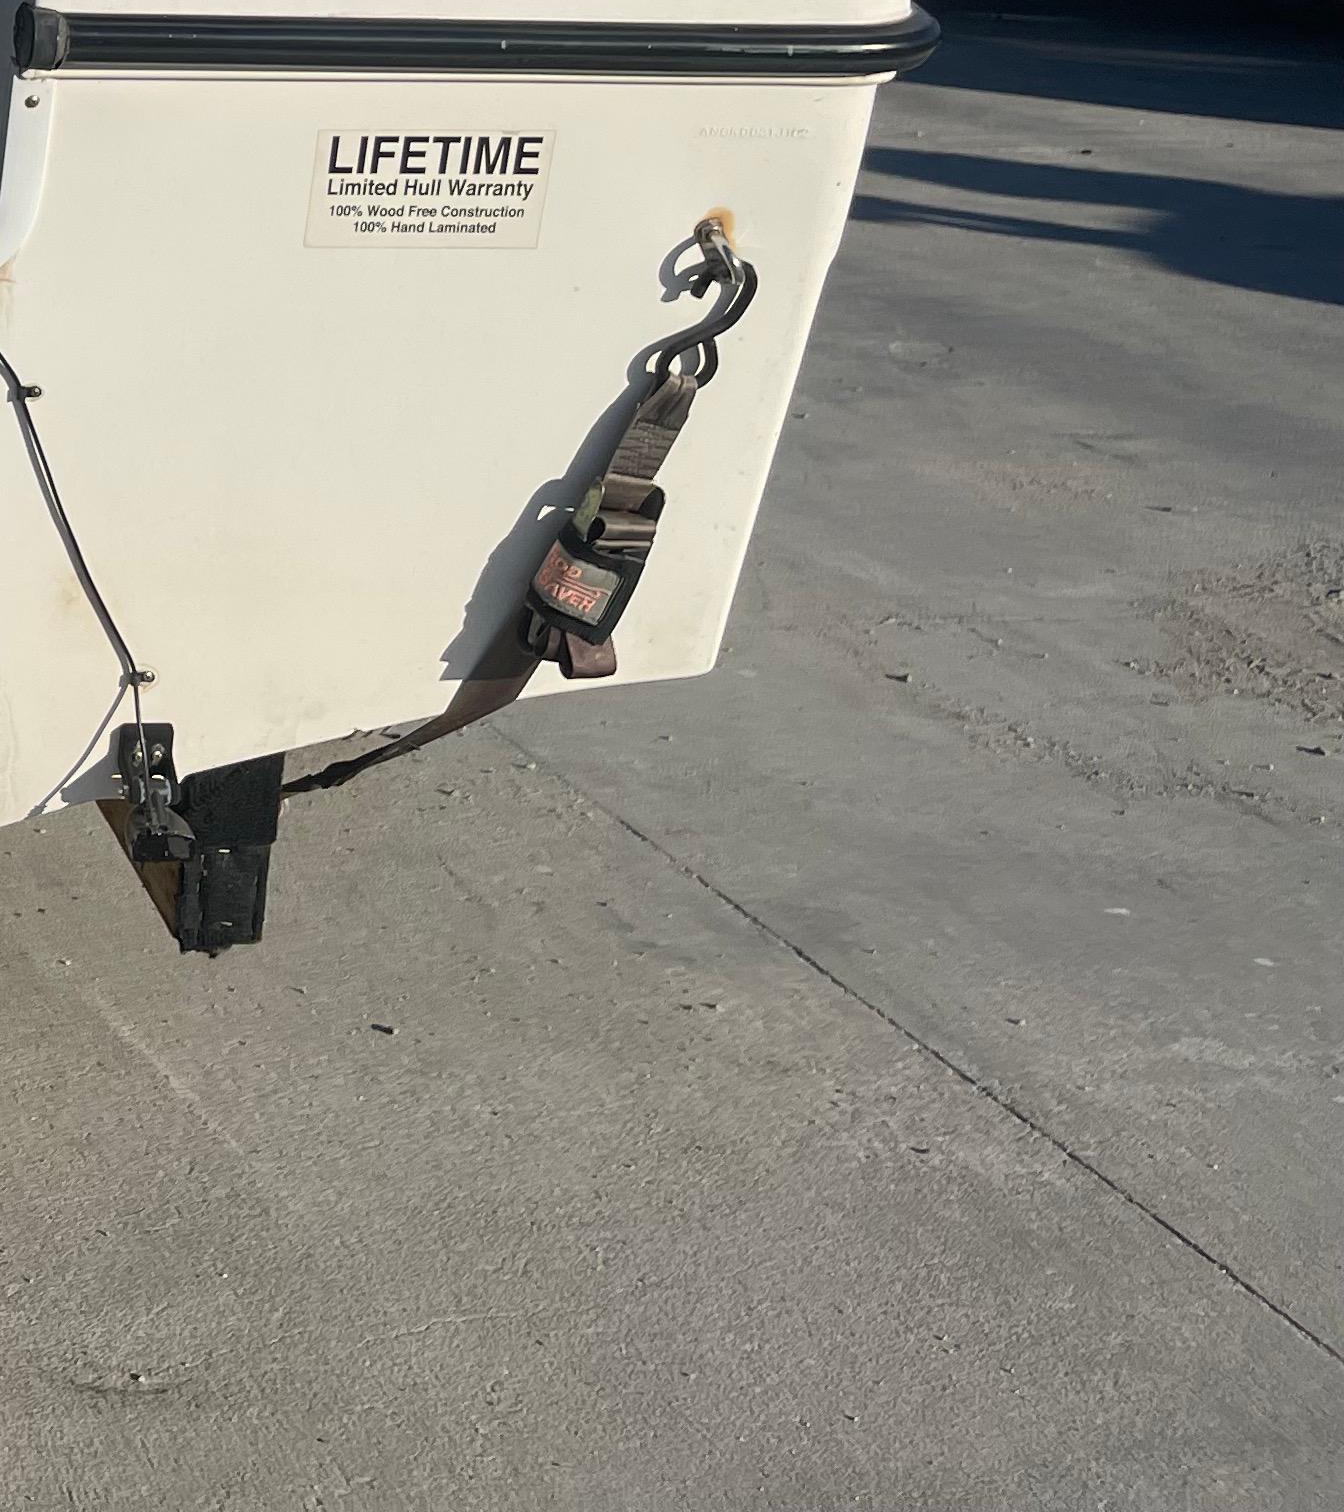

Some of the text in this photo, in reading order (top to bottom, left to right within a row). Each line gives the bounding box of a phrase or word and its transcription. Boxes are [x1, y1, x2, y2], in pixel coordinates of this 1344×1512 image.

[328, 136, 544, 175] LIFETIME
[327, 179, 534, 201] Limited Hull Warranty
[330, 205, 525, 218] 100% Wood Free Construction
[353, 221, 497, 234] 100% Hand Laminated
